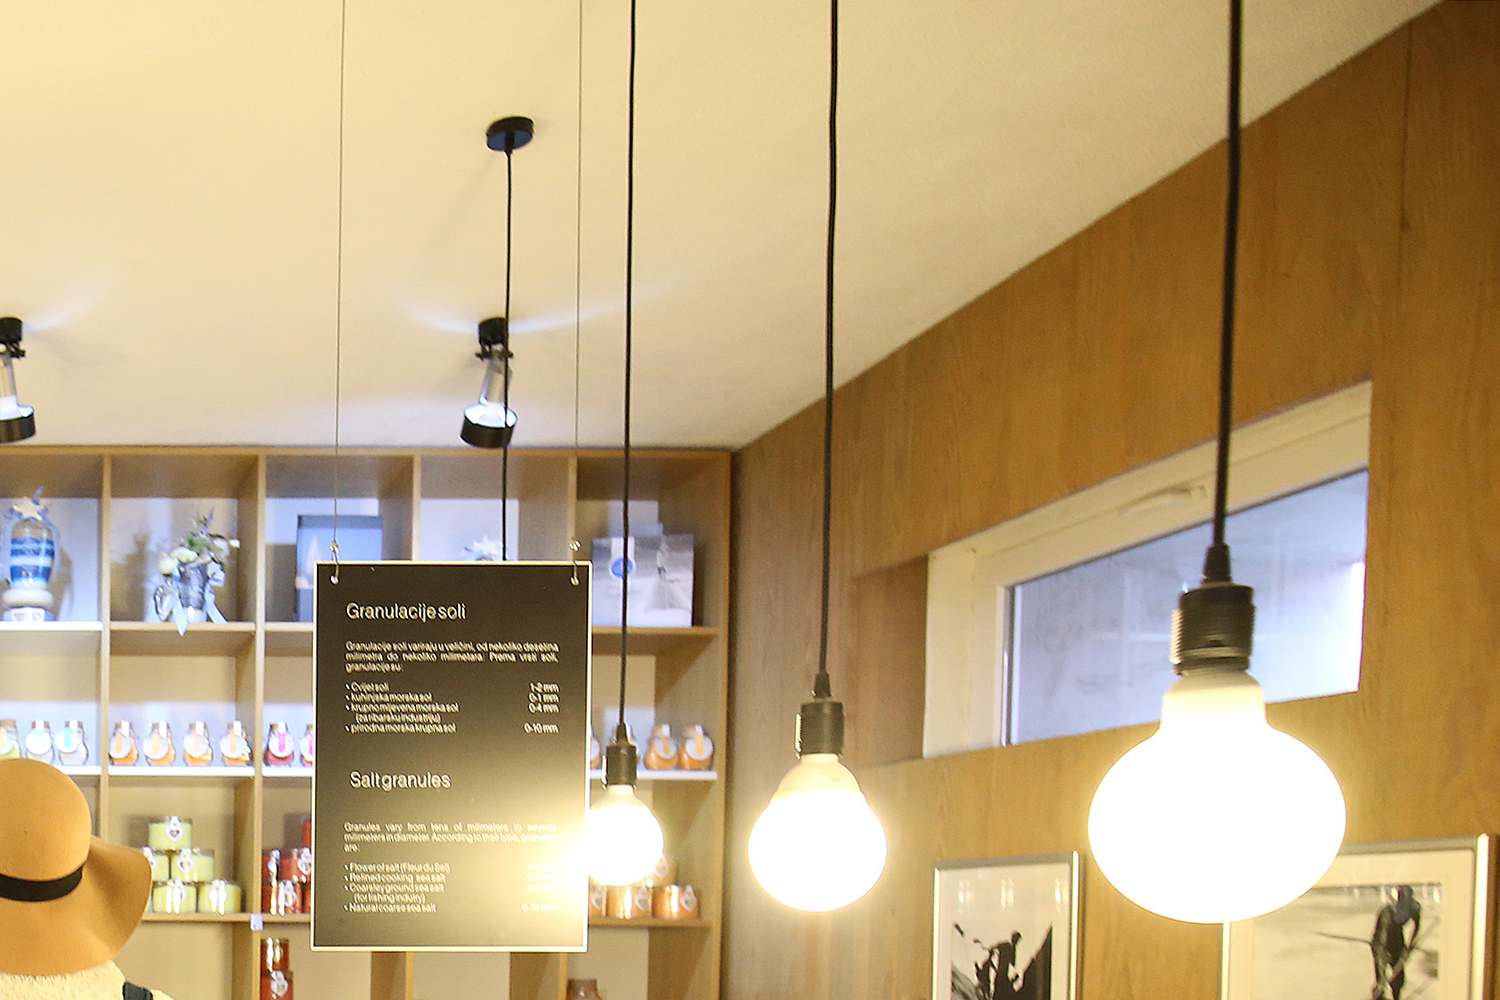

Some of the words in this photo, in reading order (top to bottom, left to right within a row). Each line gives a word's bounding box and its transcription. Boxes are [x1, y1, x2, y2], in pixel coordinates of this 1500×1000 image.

[346, 603, 437, 623] Granulacije
[438, 603, 466, 620] soli
[350, 771, 382, 788] Salt
[382, 772, 451, 791] granules
